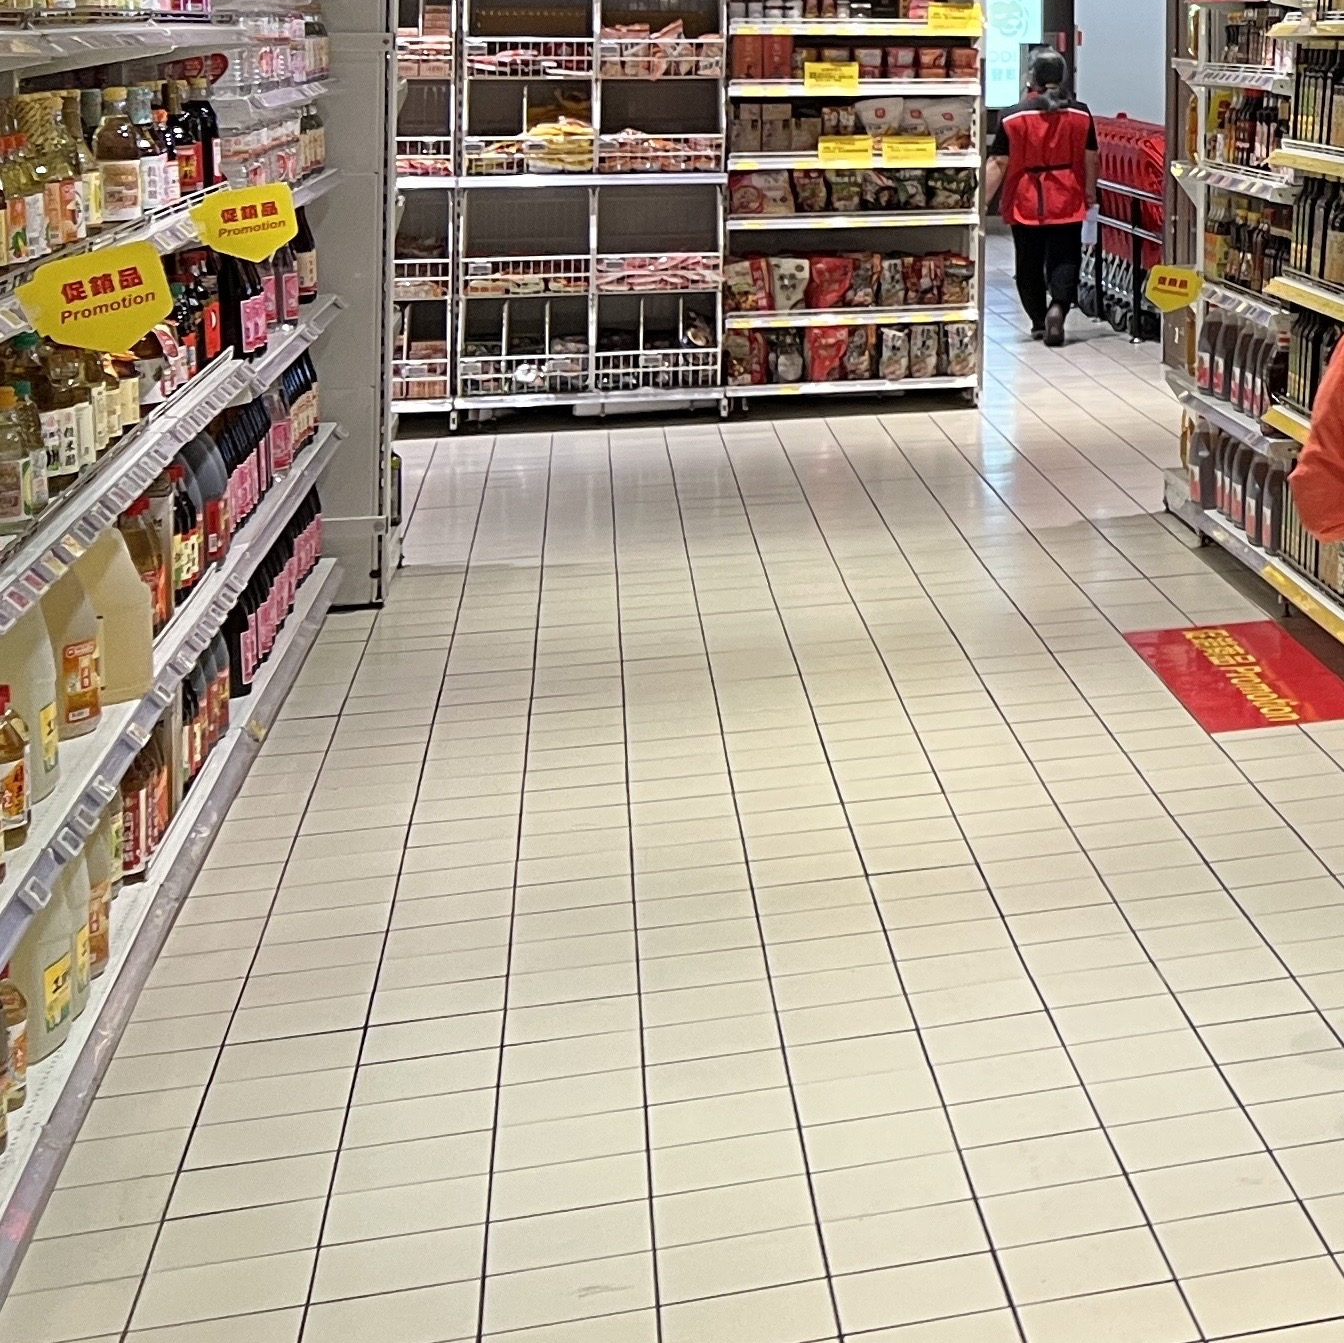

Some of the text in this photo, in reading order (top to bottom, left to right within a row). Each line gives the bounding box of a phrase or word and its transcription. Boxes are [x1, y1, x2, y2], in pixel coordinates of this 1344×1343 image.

[217, 217, 287, 238] Promotion
[219, 200, 280, 224] 促銷品
[60, 264, 145, 305] 促銷品
[59, 288, 156, 325] Promotion
[1224, 664, 1301, 723] Promotion
